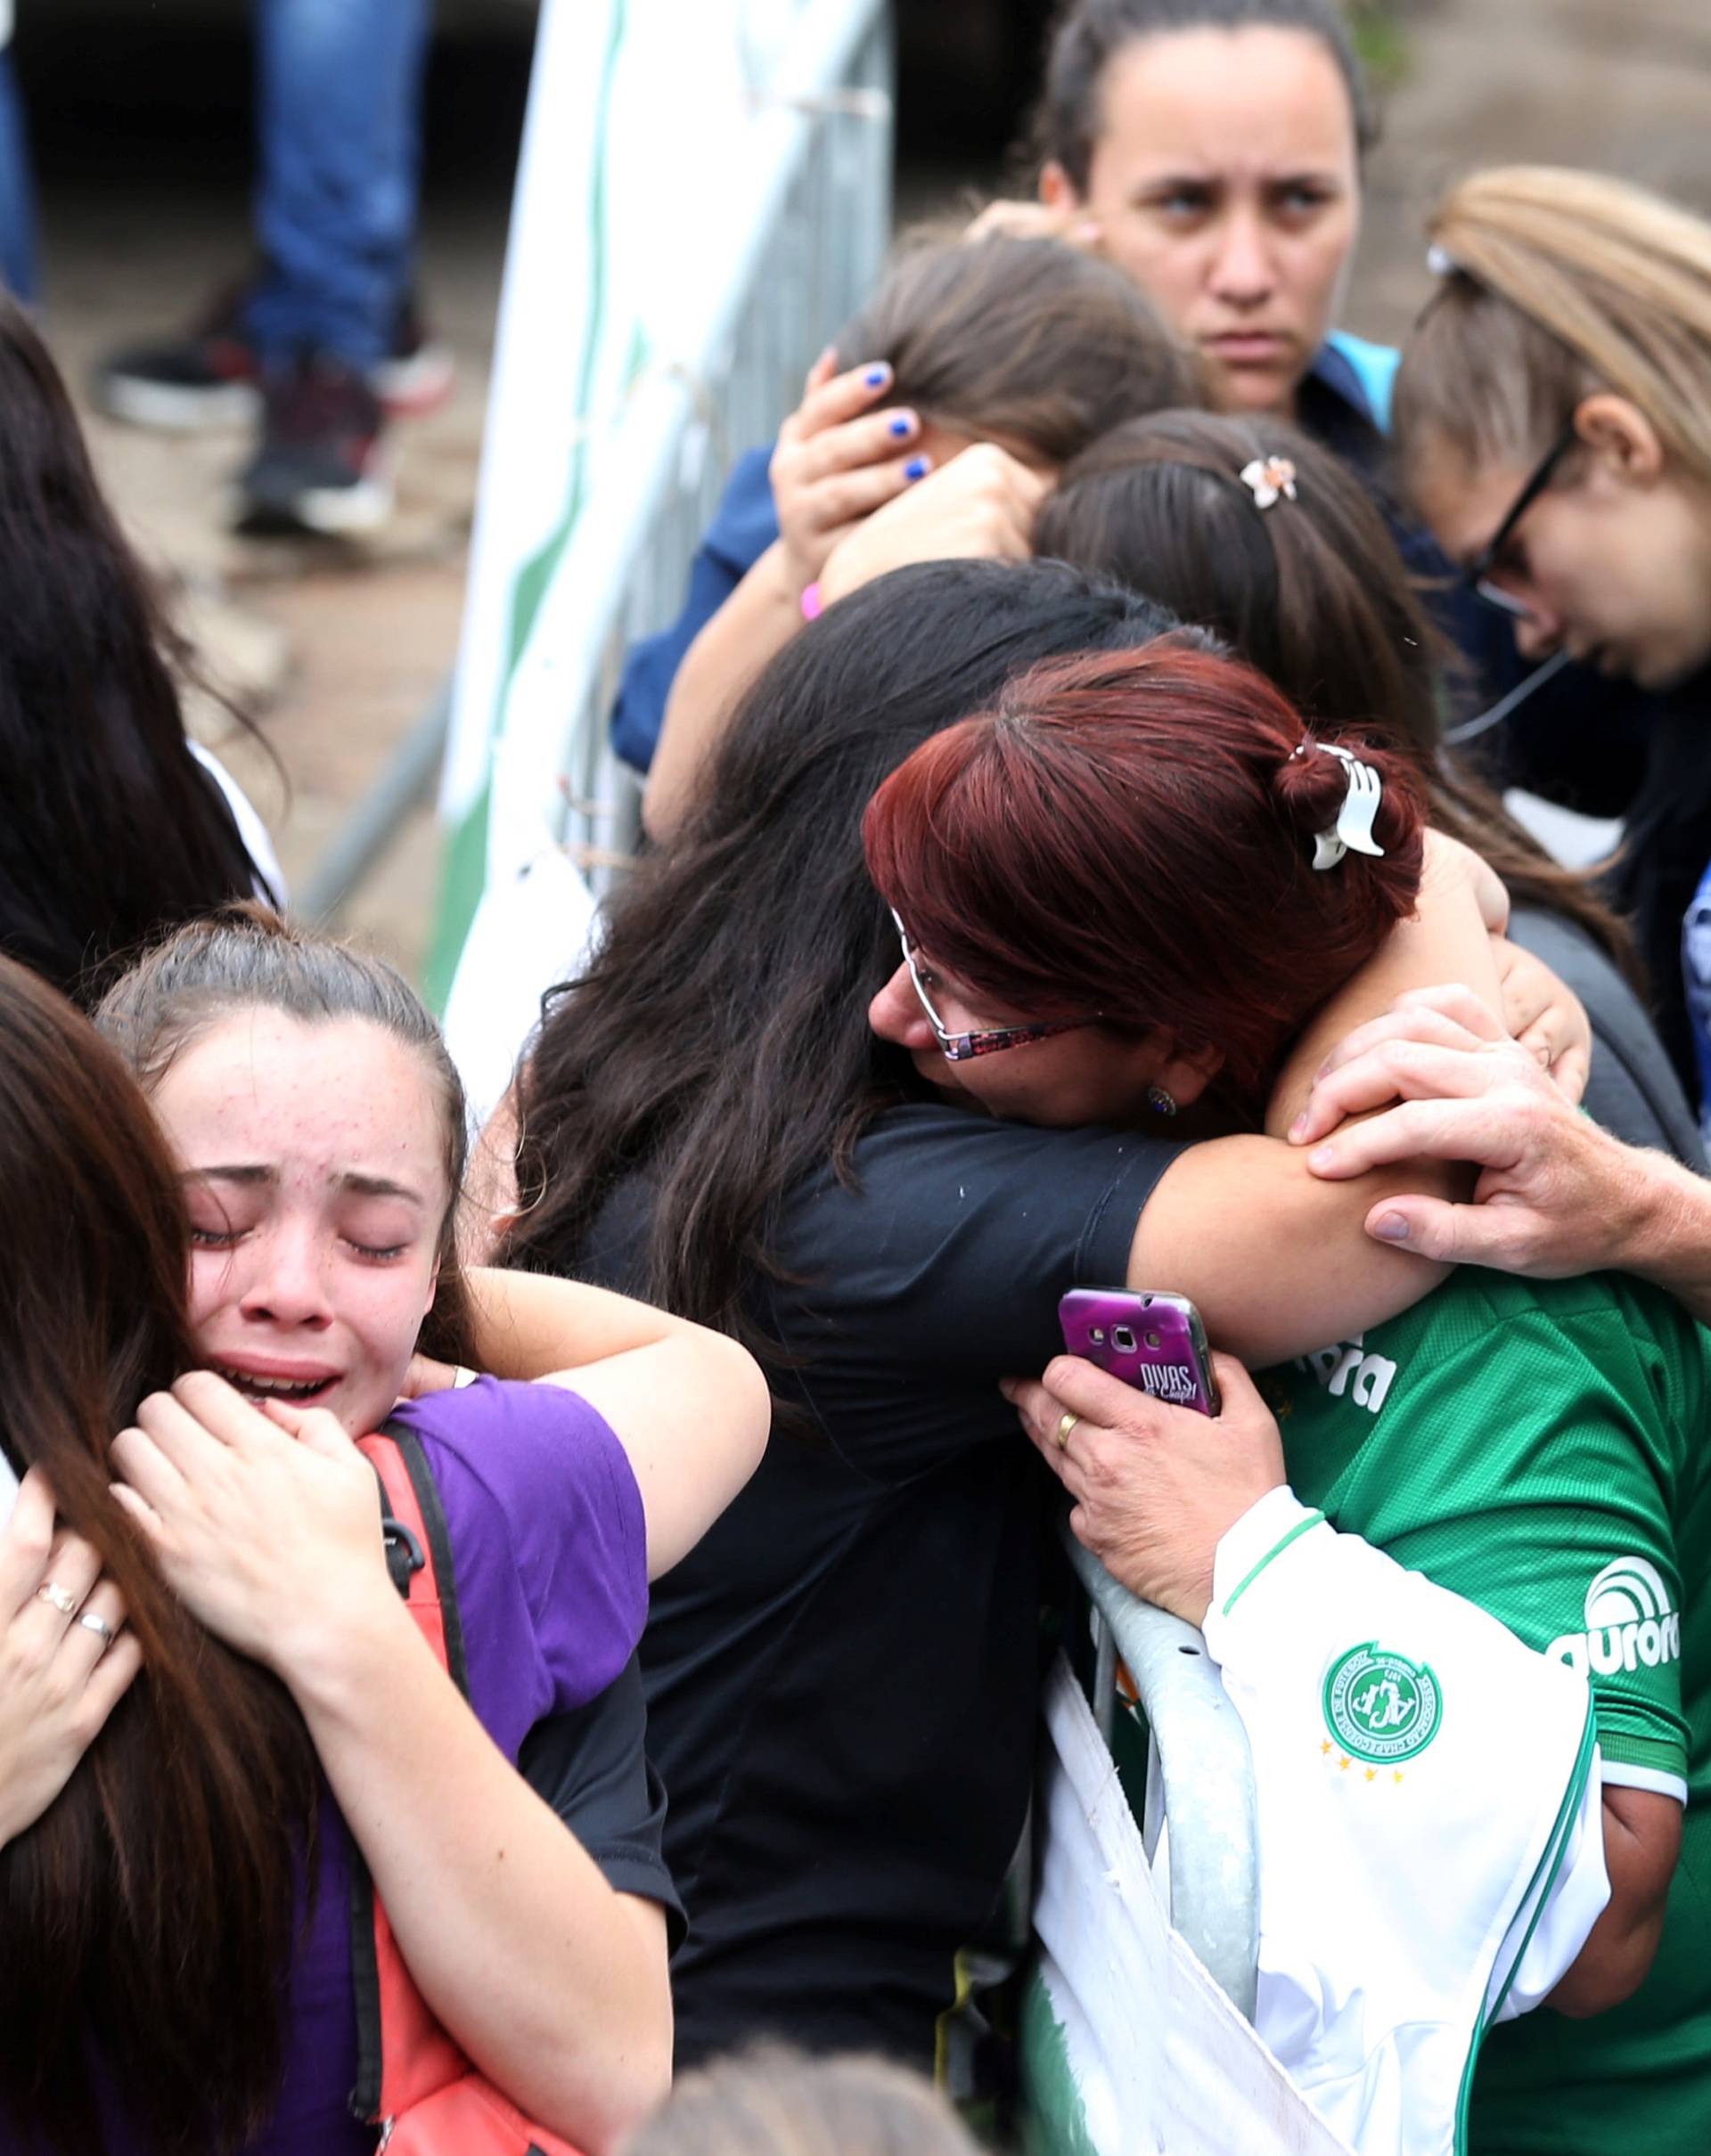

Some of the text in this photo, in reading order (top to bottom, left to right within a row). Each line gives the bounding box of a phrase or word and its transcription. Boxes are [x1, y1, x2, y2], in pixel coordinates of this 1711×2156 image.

[1141, 1363, 1192, 1390] DIVAS
[1295, 1344, 1398, 1414] ora
[1546, 1613, 1680, 1676] aurora
